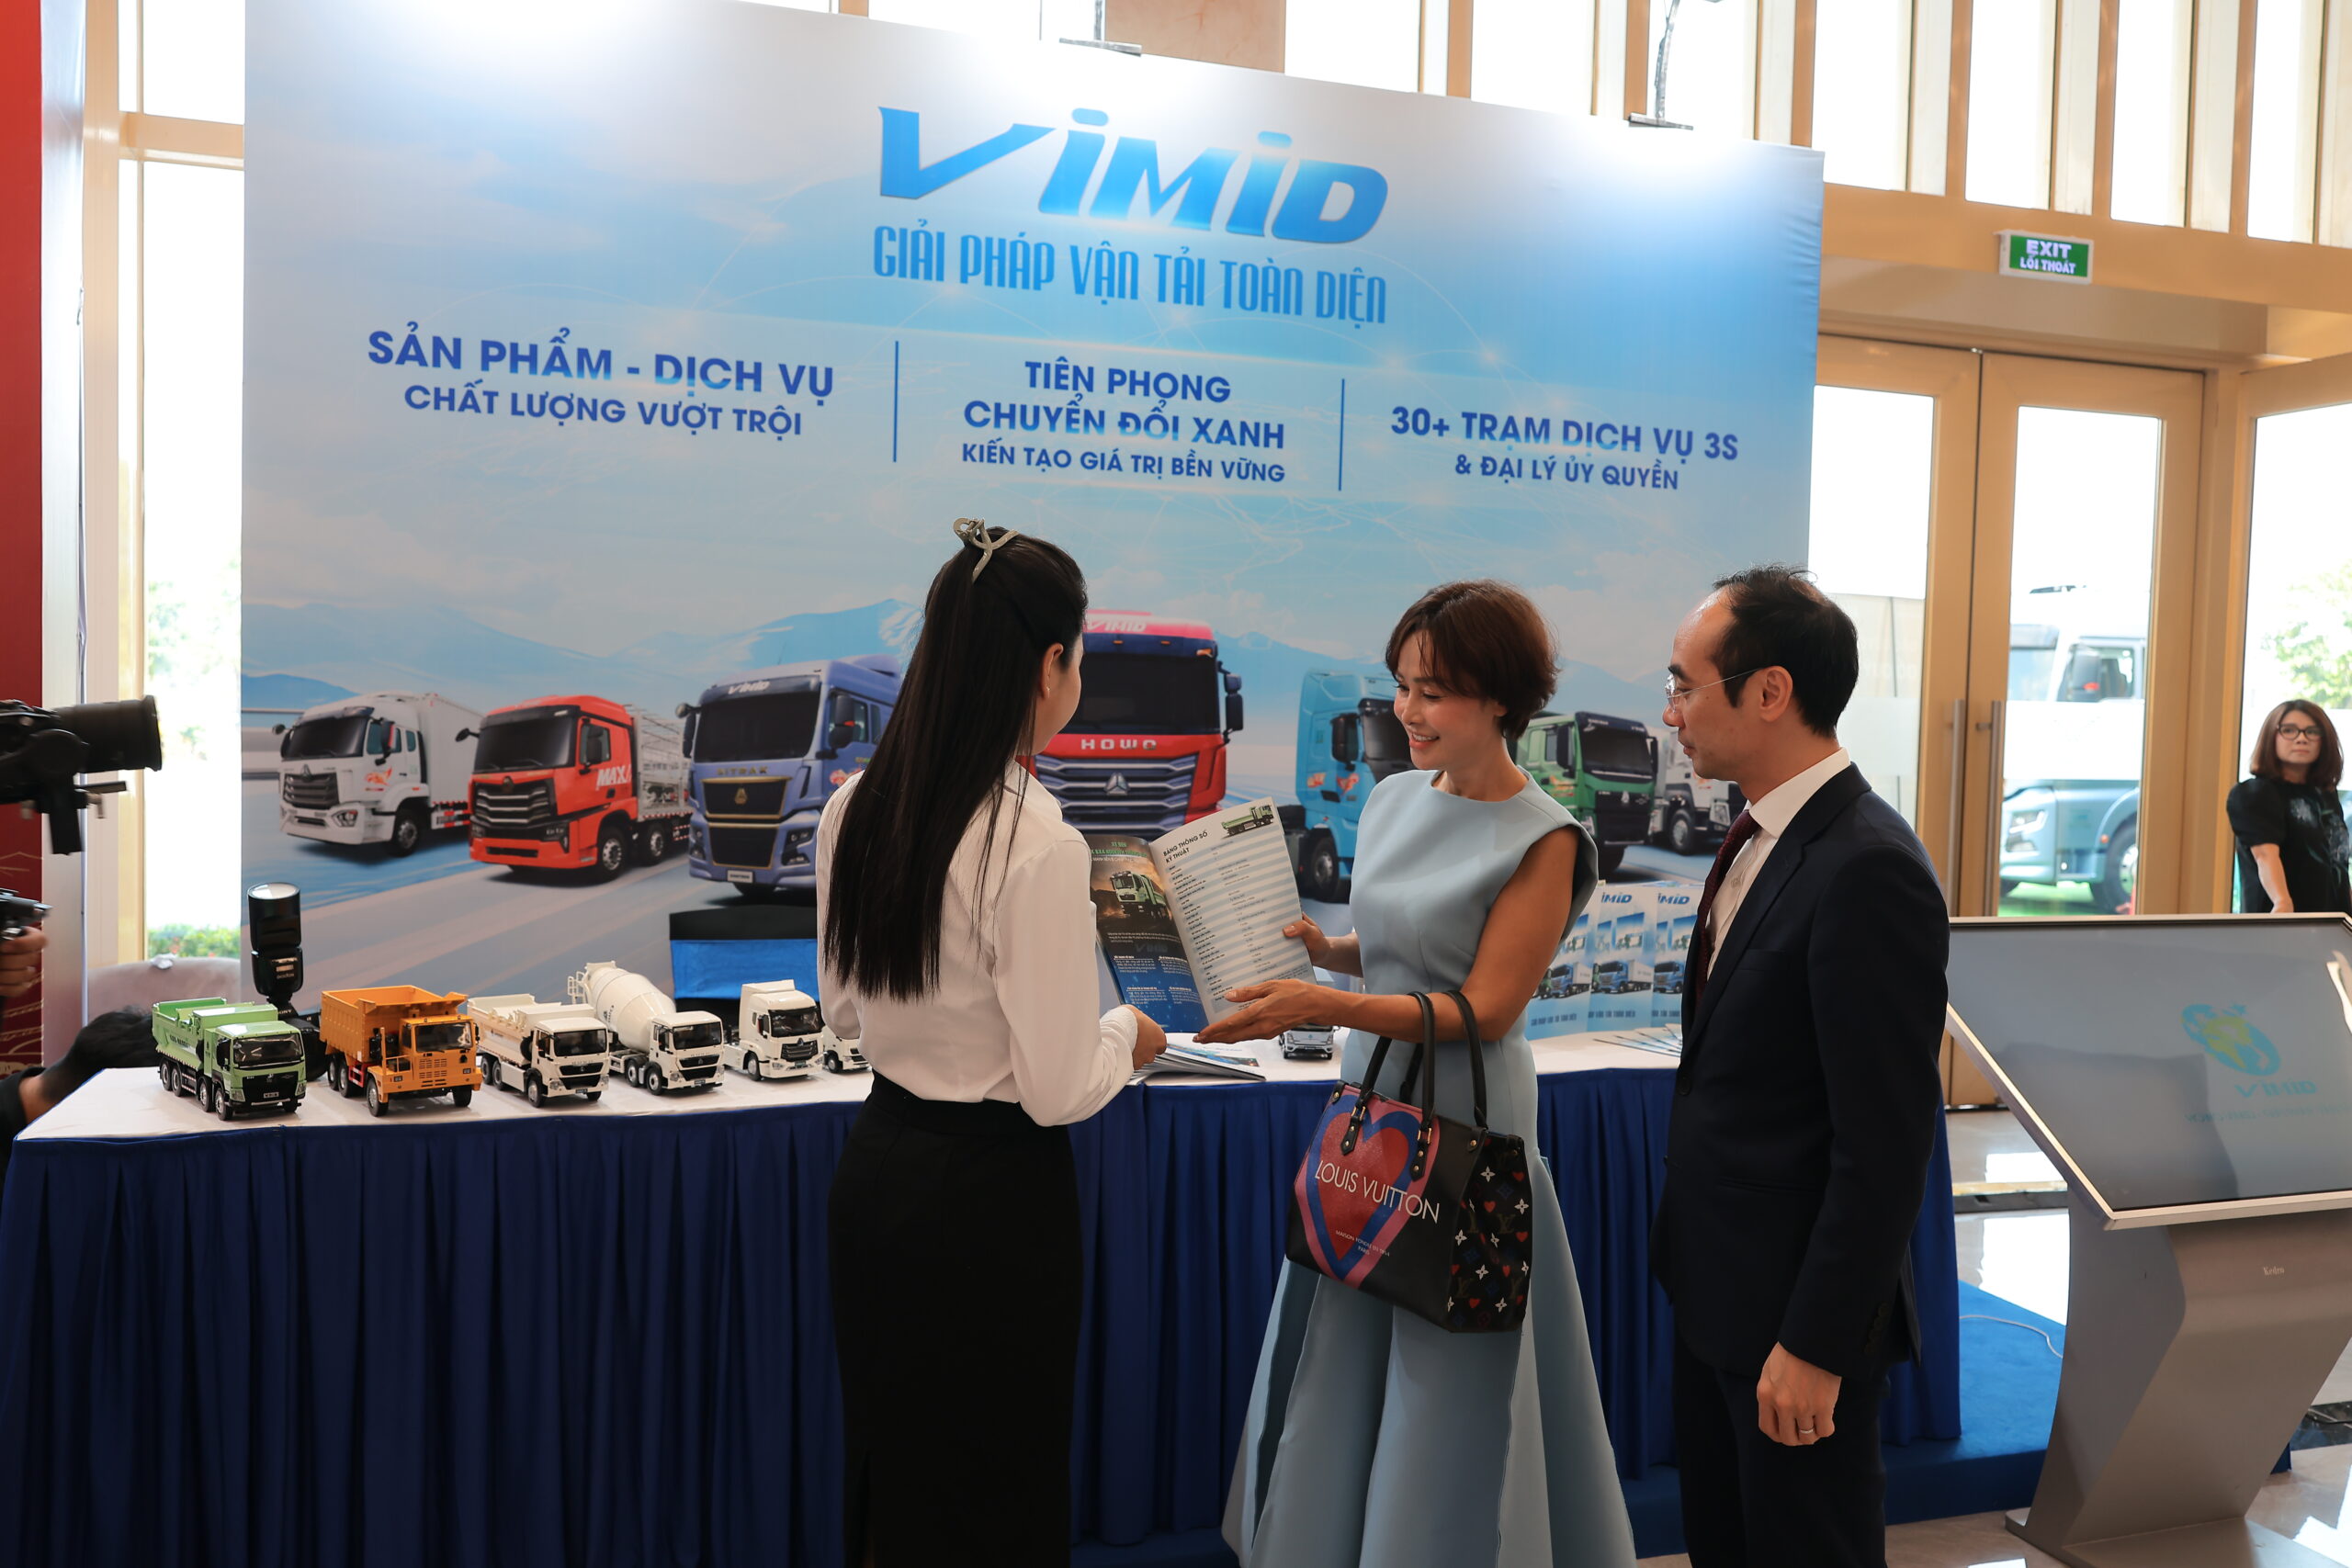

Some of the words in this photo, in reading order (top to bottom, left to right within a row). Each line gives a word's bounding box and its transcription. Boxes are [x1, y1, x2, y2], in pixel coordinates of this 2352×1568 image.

[2026, 239, 2072, 259] EXIT
[2041, 259, 2076, 275] THOÁT
[873, 218, 945, 283] GIẢI
[959, 231, 1056, 292] PHÁP
[1069, 241, 1139, 306] VẬN
[1153, 246, 1205, 307] TẢI
[1219, 257, 1304, 316] TOÀN
[1315, 267, 1387, 330] DIỆN
[368, 321, 462, 370] SẢN
[480, 327, 613, 381] PHẨM
[654, 354, 763, 397] DỊCH
[777, 363, 834, 407] VỤ
[1024, 355, 1094, 393] TIÊN
[1107, 367, 1231, 403] PHONG
[403, 378, 499, 415] CHẤT
[510, 389, 626, 427] LƯỢNG
[637, 400, 723, 436] VƯỢT
[731, 404, 802, 442] TRỘI
[963, 392, 1105, 435] CHUYỂN
[1117, 399, 1181, 442] ĐỔI
[1191, 416, 1284, 449] XANH
[961, 436, 1015, 466] KIẾN
[1023, 446, 1072, 473] TẠO
[1080, 448, 1124, 472] GIÁ
[1130, 454, 1164, 480] TRỊ
[1171, 449, 1213, 479] BỀN
[1220, 457, 1285, 482] VỮNG
[1390, 406, 1451, 437] 30+
[1461, 411, 1551, 451] TRẠM
[1562, 419, 1643, 457] DỊCH
[1652, 427, 1694, 465] VỤ
[1703, 432, 1739, 461] 3S
[1454, 454, 1471, 476] &
[1480, 455, 1523, 485] ĐẠI
[1531, 455, 1557, 481] LÝ
[1565, 455, 1595, 484] ỦY
[1601, 458, 1679, 491] QUYỀN
[1080, 739, 1158, 750] HOWO
[1314, 1159, 1359, 1193] LOUIS
[1363, 1176, 1440, 1224] VUITTON
